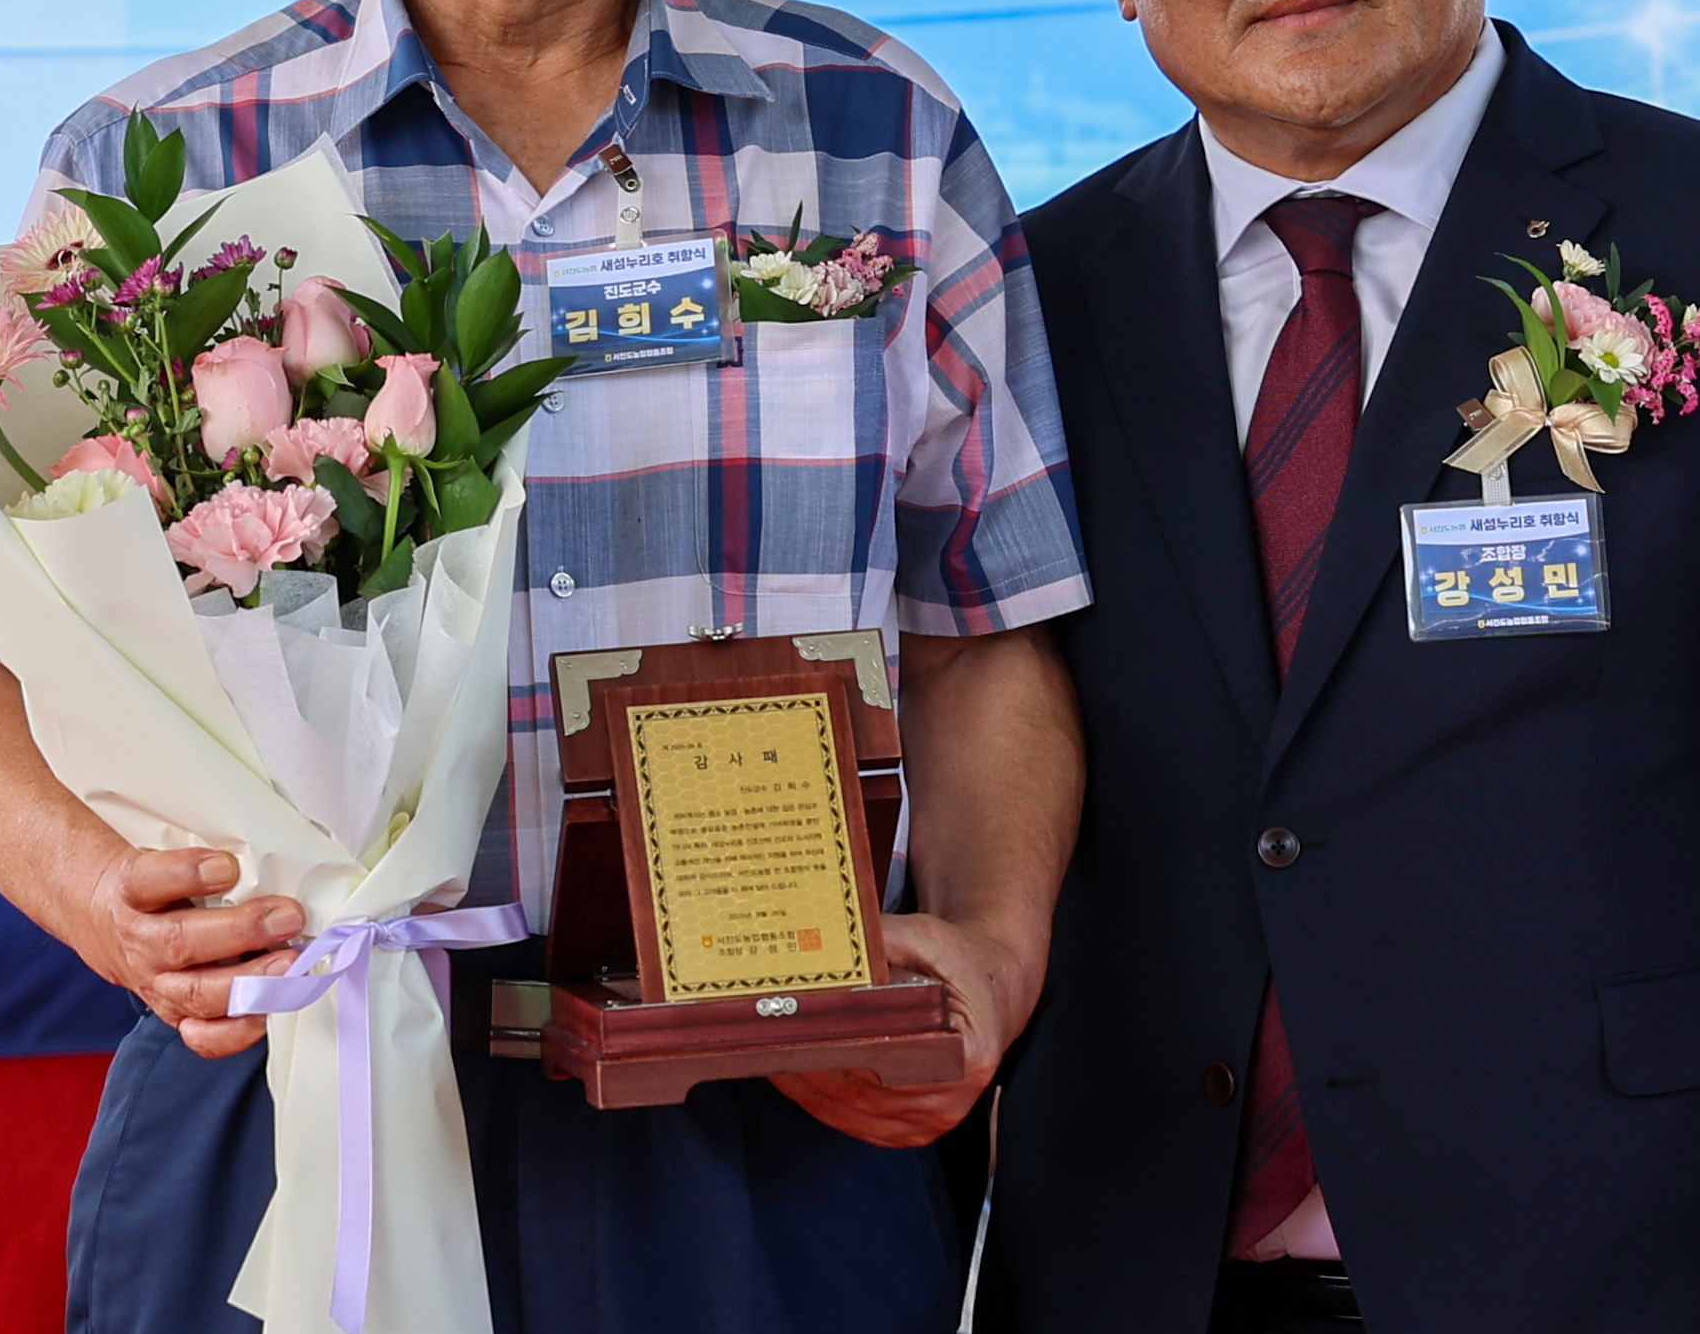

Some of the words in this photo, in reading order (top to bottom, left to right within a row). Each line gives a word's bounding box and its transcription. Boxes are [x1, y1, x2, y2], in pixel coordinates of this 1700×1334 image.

[600, 252, 665, 272] 새섬누리호
[667, 247, 706, 264] 취항식
[603, 279, 662, 300] 진도군수
[565, 297, 705, 344] 김희수
[1429, 523, 1466, 534] 서진도농협
[1470, 515, 1536, 532] 새섬누리호
[1540, 511, 1579, 526] 취항식
[1481, 545, 1526, 562] 조합장
[1434, 562, 1579, 607] 강성민
